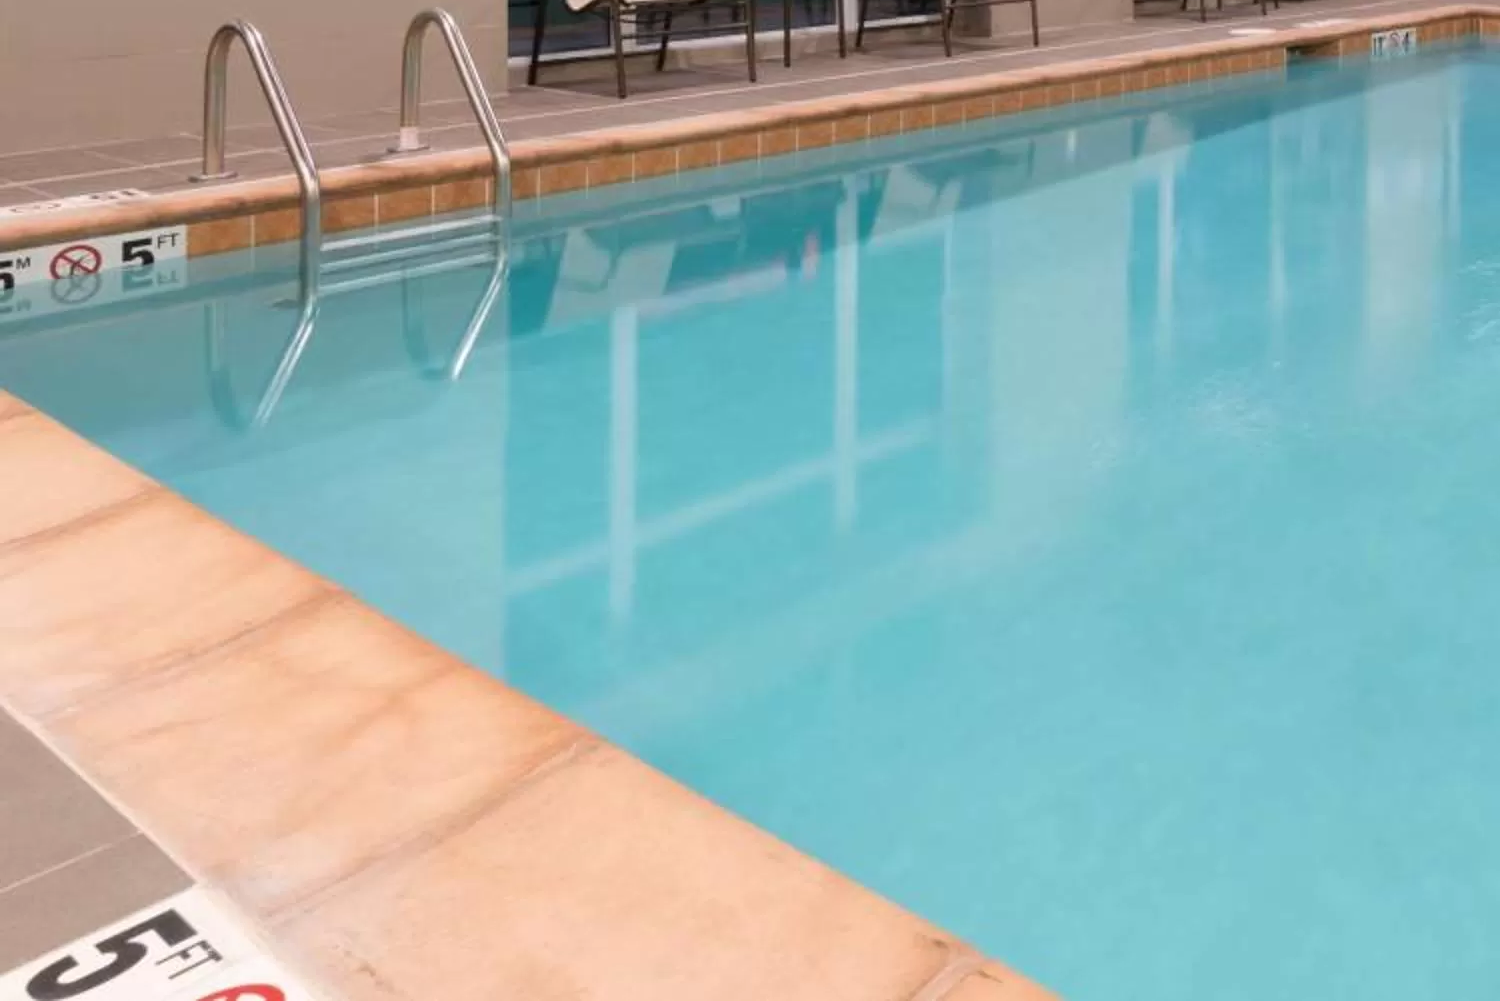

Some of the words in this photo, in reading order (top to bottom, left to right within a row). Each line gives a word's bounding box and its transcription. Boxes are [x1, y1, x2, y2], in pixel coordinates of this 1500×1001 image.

[122, 237, 154, 266] 5
[157, 232, 180, 249] FT
[26, 908, 198, 1001] 5
